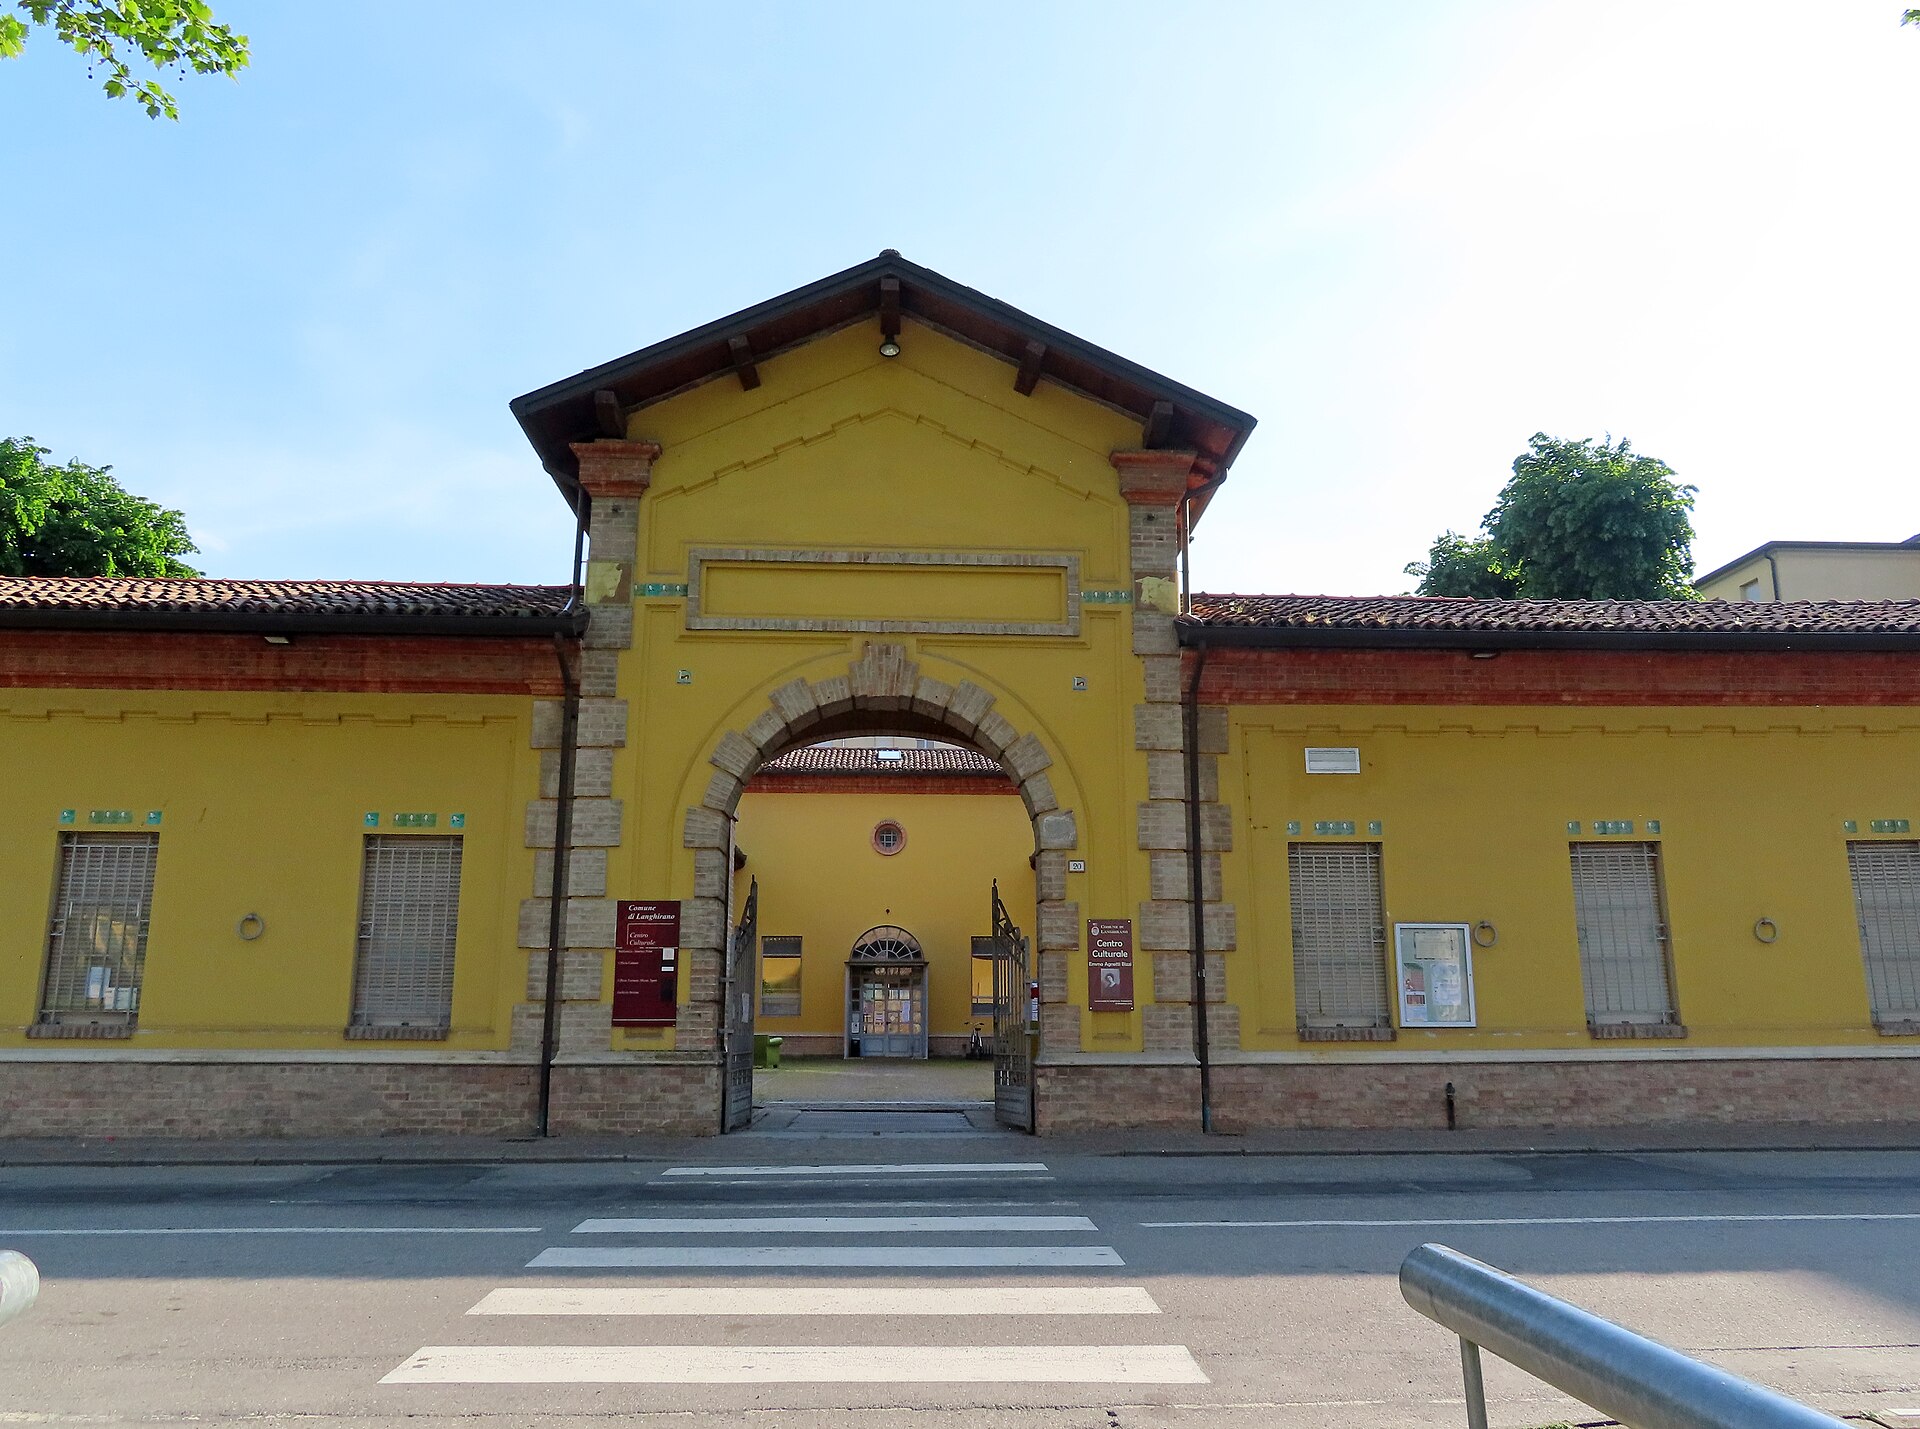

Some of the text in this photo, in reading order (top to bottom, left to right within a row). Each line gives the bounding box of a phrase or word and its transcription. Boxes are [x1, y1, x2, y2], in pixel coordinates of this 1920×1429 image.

[1072, 862, 1082, 870] 20
[628, 904, 657, 912] Comune
[636, 913, 676, 921] Langhirano
[1096, 939, 1123, 947] Centro
[1092, 950, 1128, 958] Culturale
